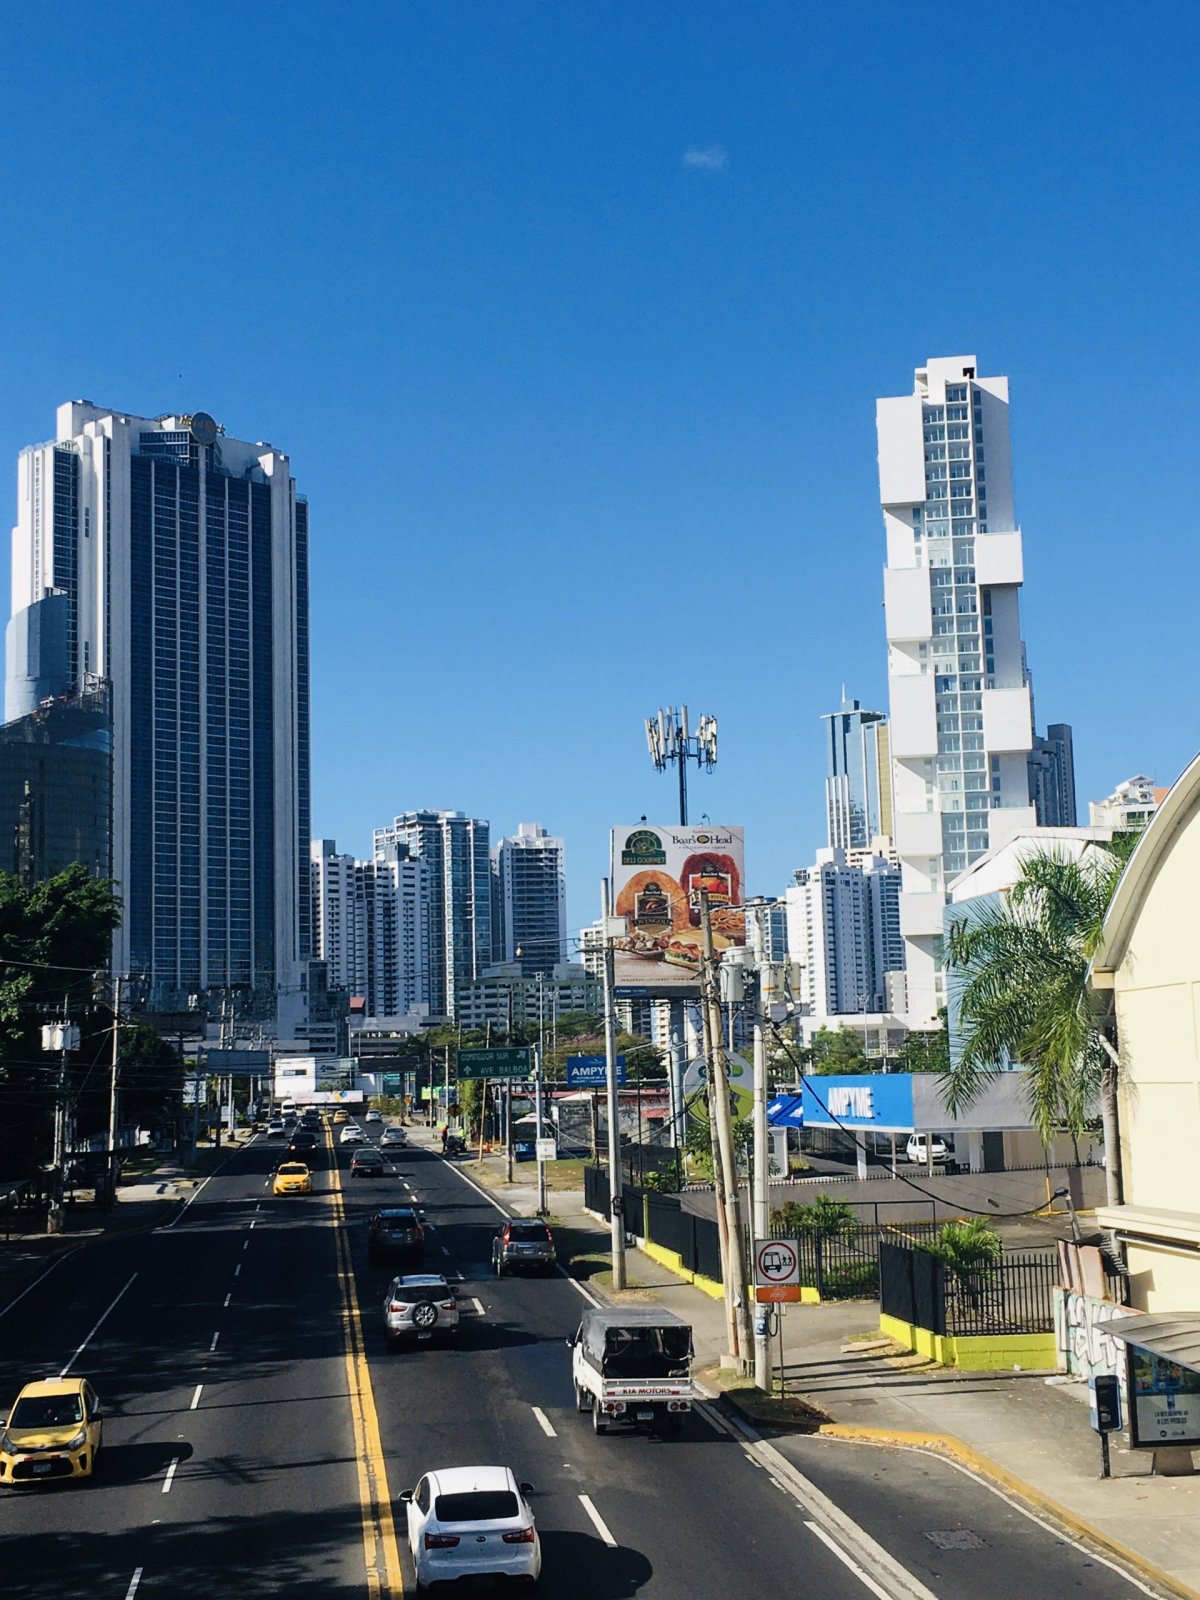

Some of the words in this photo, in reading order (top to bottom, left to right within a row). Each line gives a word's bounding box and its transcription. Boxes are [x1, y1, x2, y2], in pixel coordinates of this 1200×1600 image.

[672, 835, 696, 845] Boar's
[710, 834, 733, 844] Head
[623, 856, 636, 864] DELI
[480, 1066, 494, 1076] AVE
[499, 1065, 528, 1074] BALBOA
[571, 1066, 622, 1076] AMPYE
[828, 1087, 873, 1118] AMPYME
